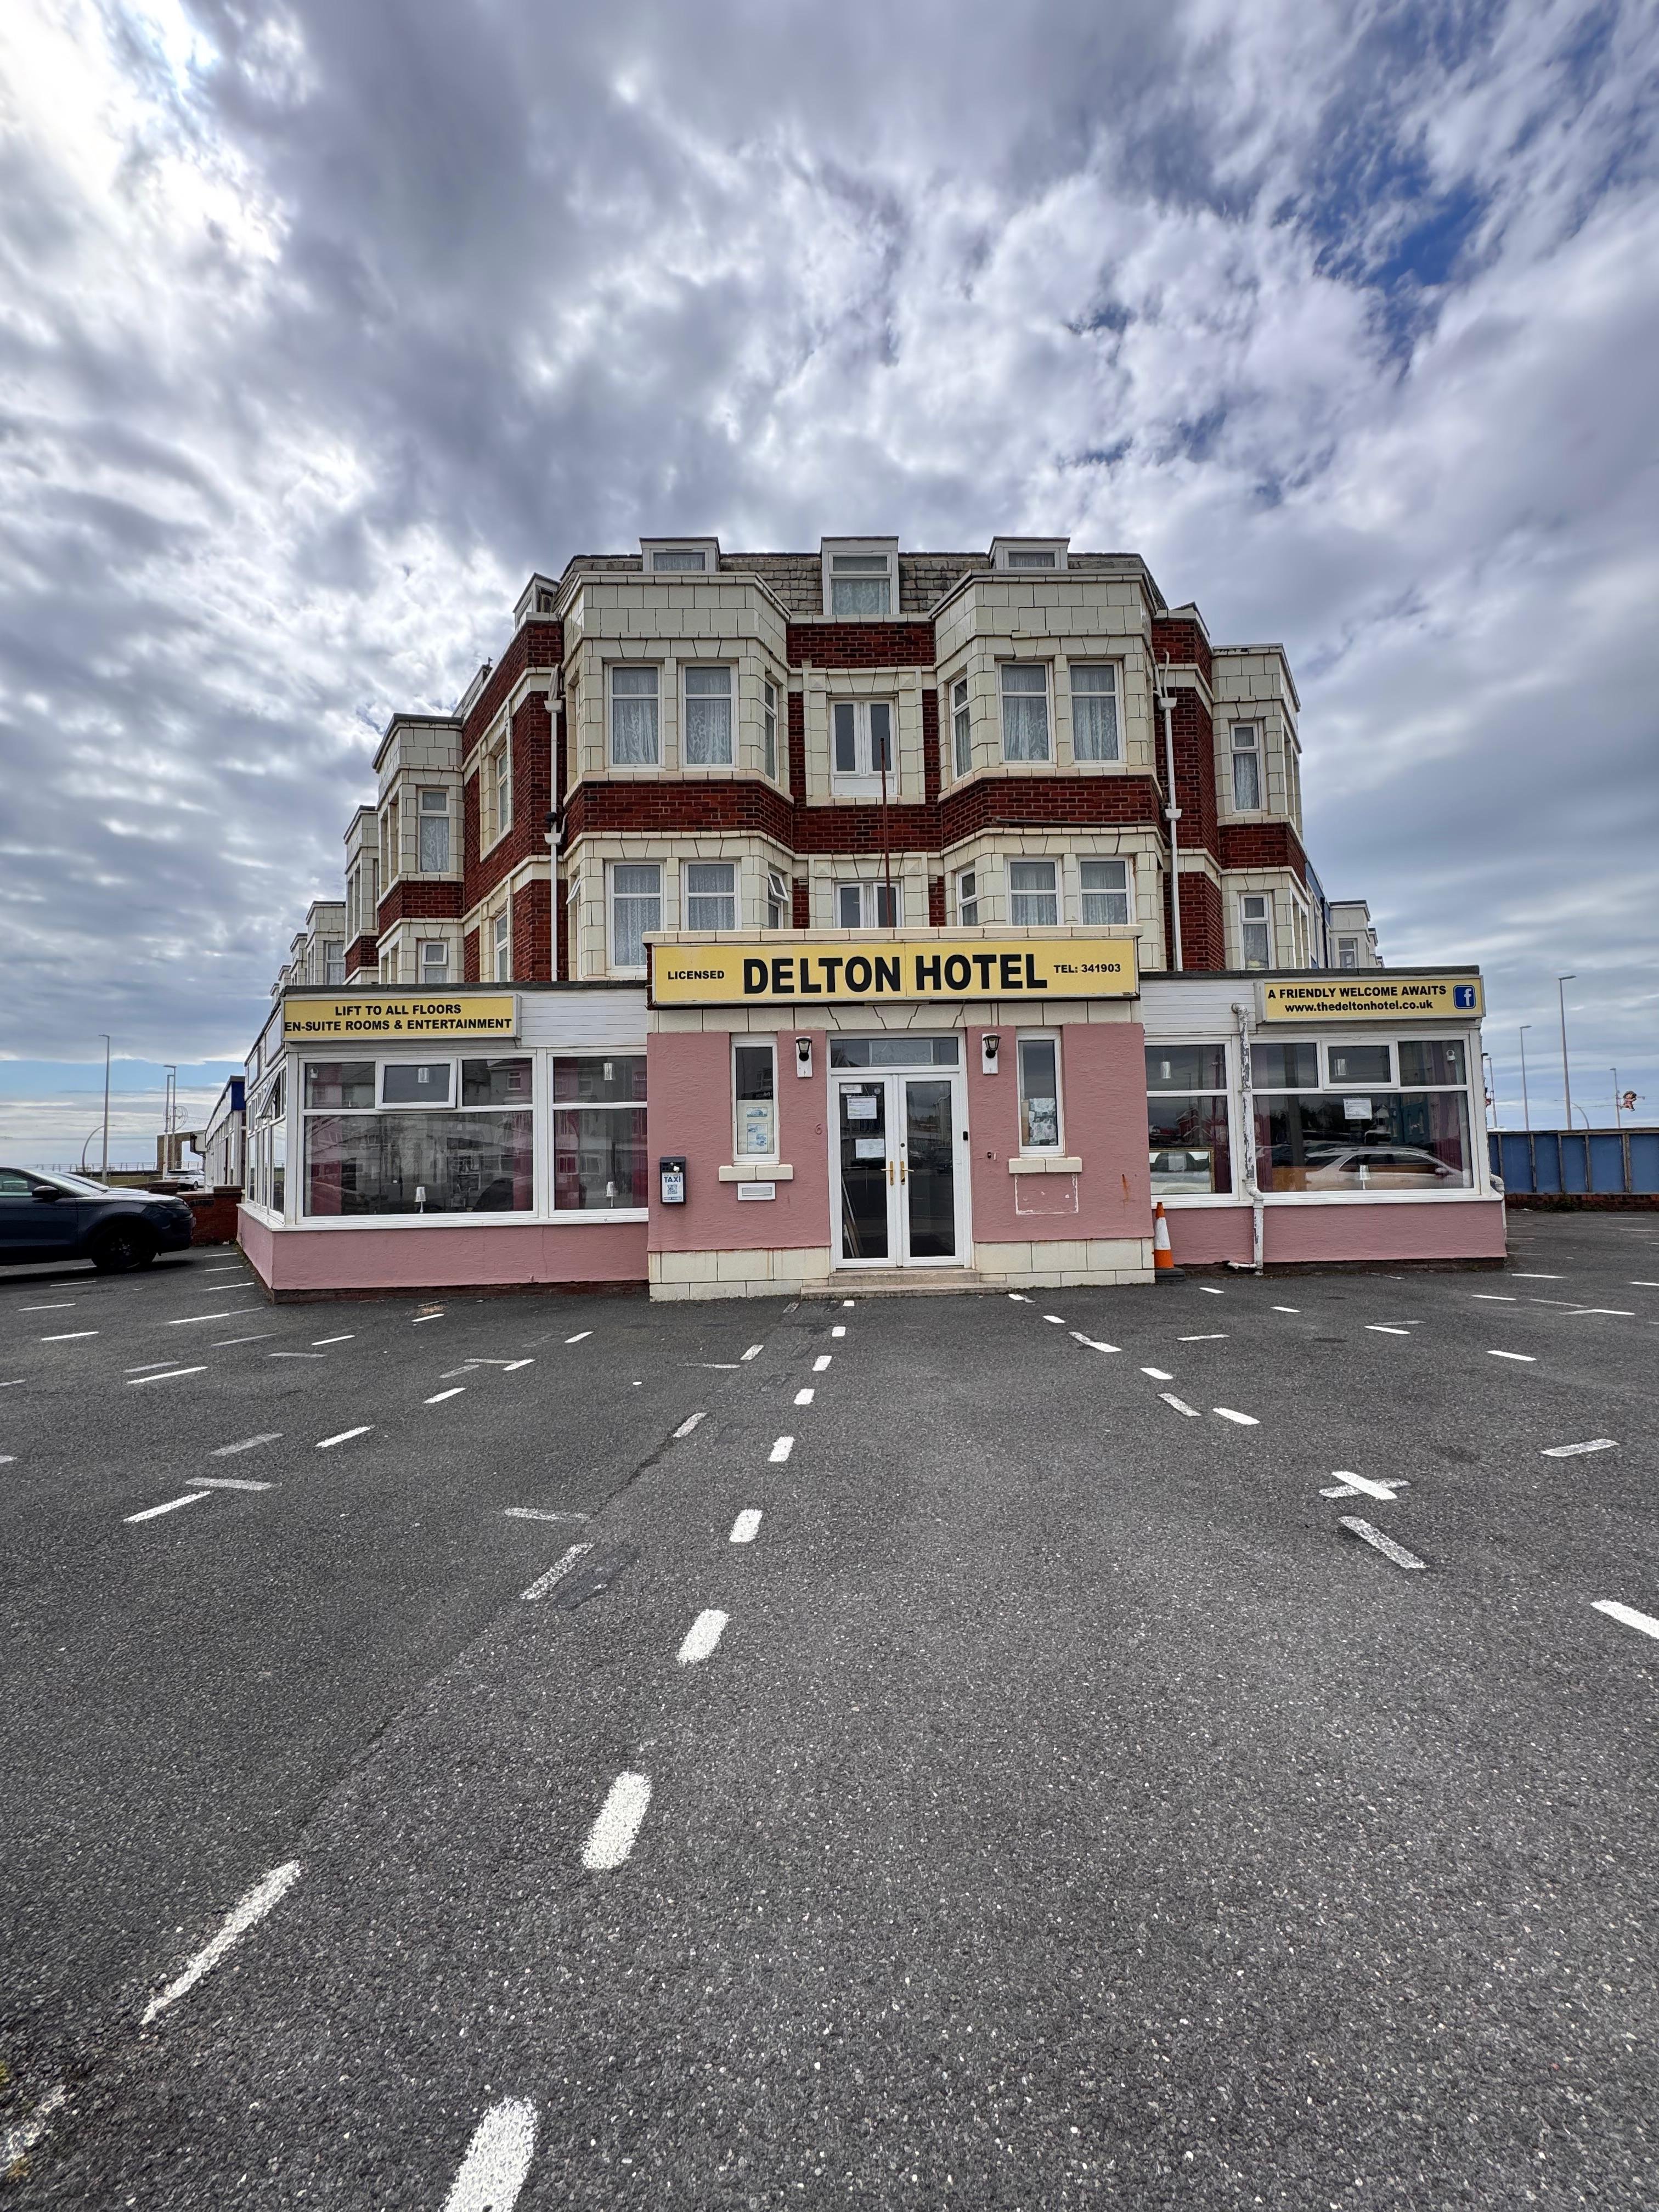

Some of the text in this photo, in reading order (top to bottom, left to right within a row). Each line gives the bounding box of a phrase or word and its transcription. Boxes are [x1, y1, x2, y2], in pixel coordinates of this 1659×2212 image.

[743, 953, 1047, 994] DELTON HOTEL
[1053, 963, 1121, 974] TEL: 341903
[668, 970, 725, 980] LICENSED
[1267, 985, 1447, 999] A FRIENDLY WELCOME AWAITS
[335, 1004, 461, 1016] LIFT TO ALL FLOORS
[1284, 999, 1434, 1012] www.thedeltonhotel.co.uk
[284, 1018, 512, 1031] EN-SUITE ROOMS & ENTERTAINMENT
[815, 1123, 823, 1135] 6
